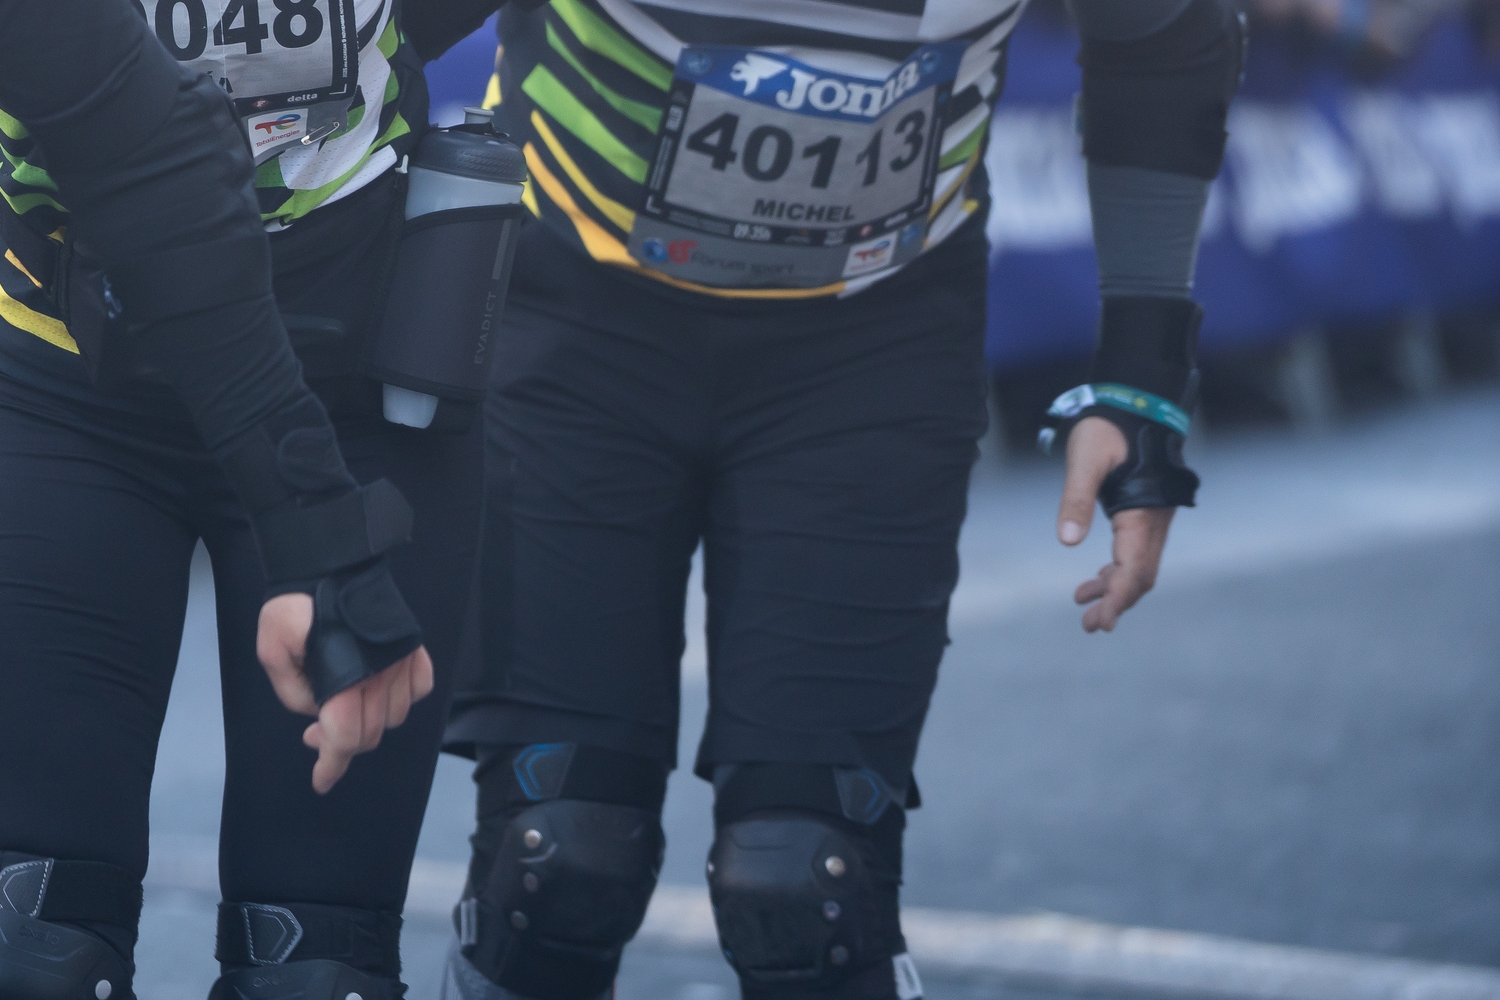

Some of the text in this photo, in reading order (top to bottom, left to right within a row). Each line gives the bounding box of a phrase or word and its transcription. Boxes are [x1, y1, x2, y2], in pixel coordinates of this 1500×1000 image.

[287, 92, 318, 103] delta
[776, 60, 920, 117] Joma
[255, 128, 300, 148] TotalEnergies
[686, 109, 926, 189] 40113
[752, 198, 855, 223] MICHEL
[473, 291, 497, 365] EVADICT
